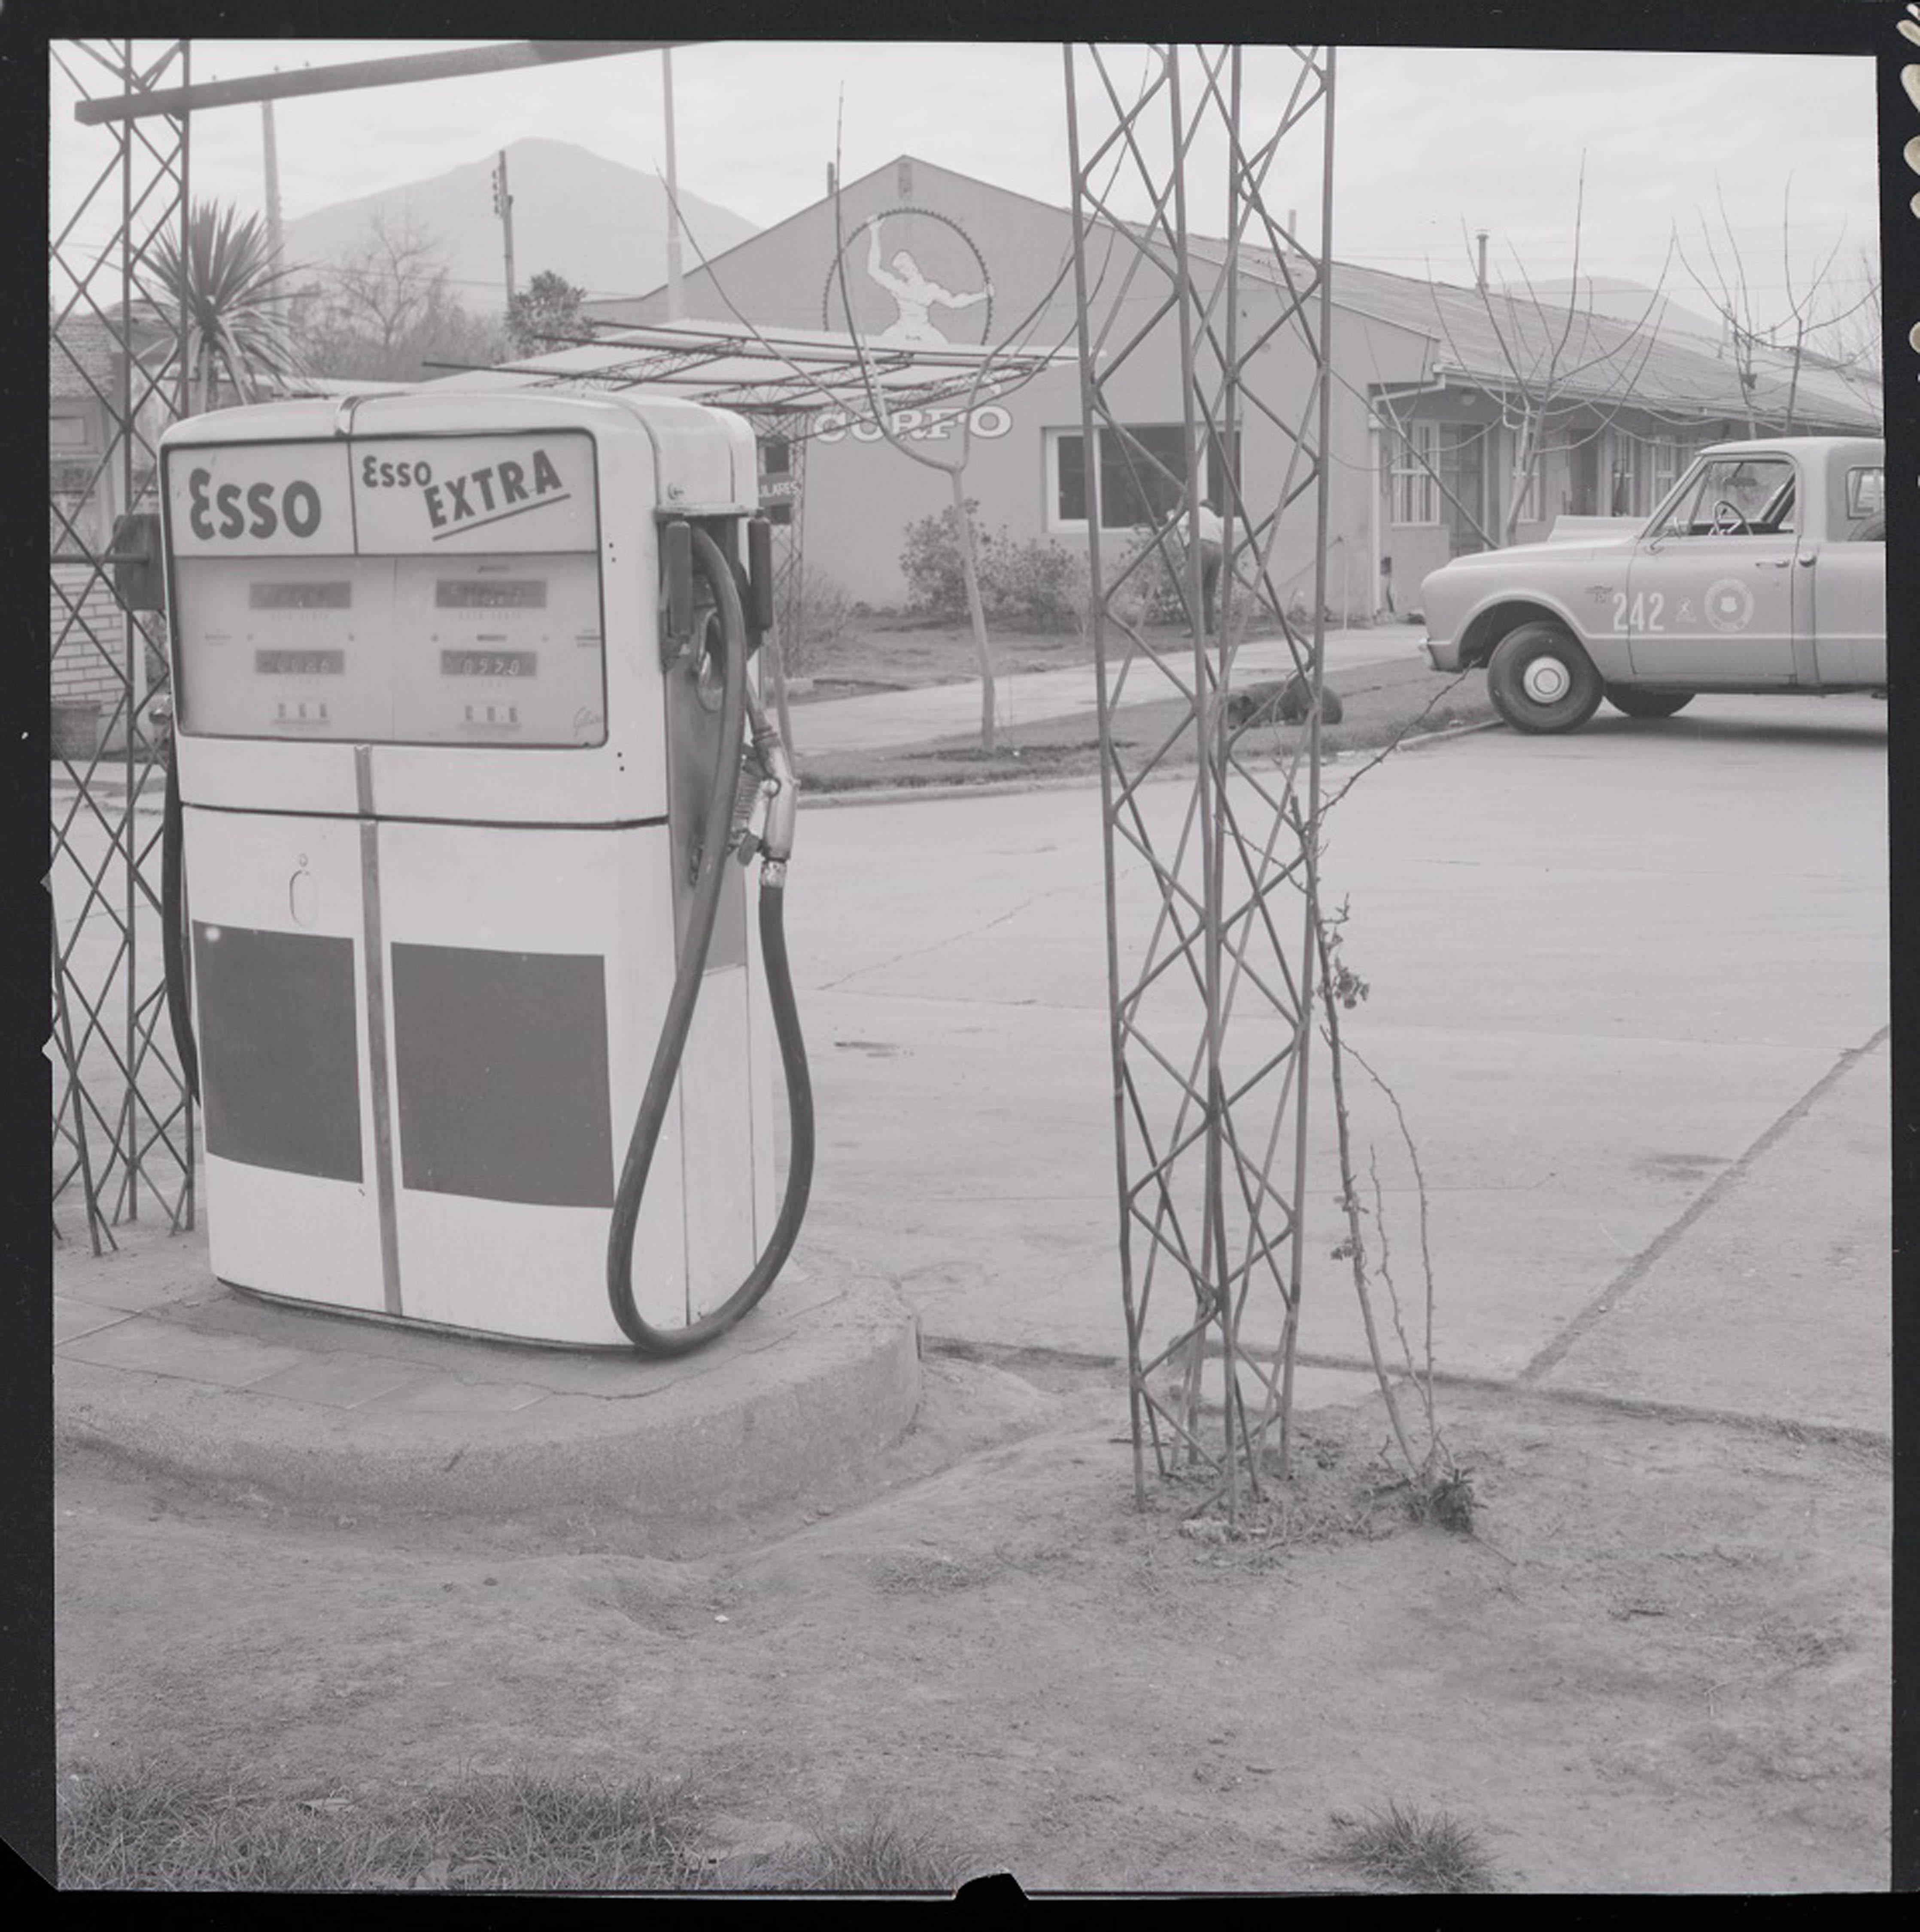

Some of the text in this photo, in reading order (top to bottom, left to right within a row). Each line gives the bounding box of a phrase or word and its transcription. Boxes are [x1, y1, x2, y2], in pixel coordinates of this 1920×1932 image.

[814, 405, 1012, 443] CORFO
[424, 450, 562, 528] EXTRA
[1613, 592, 1664, 631] 242
